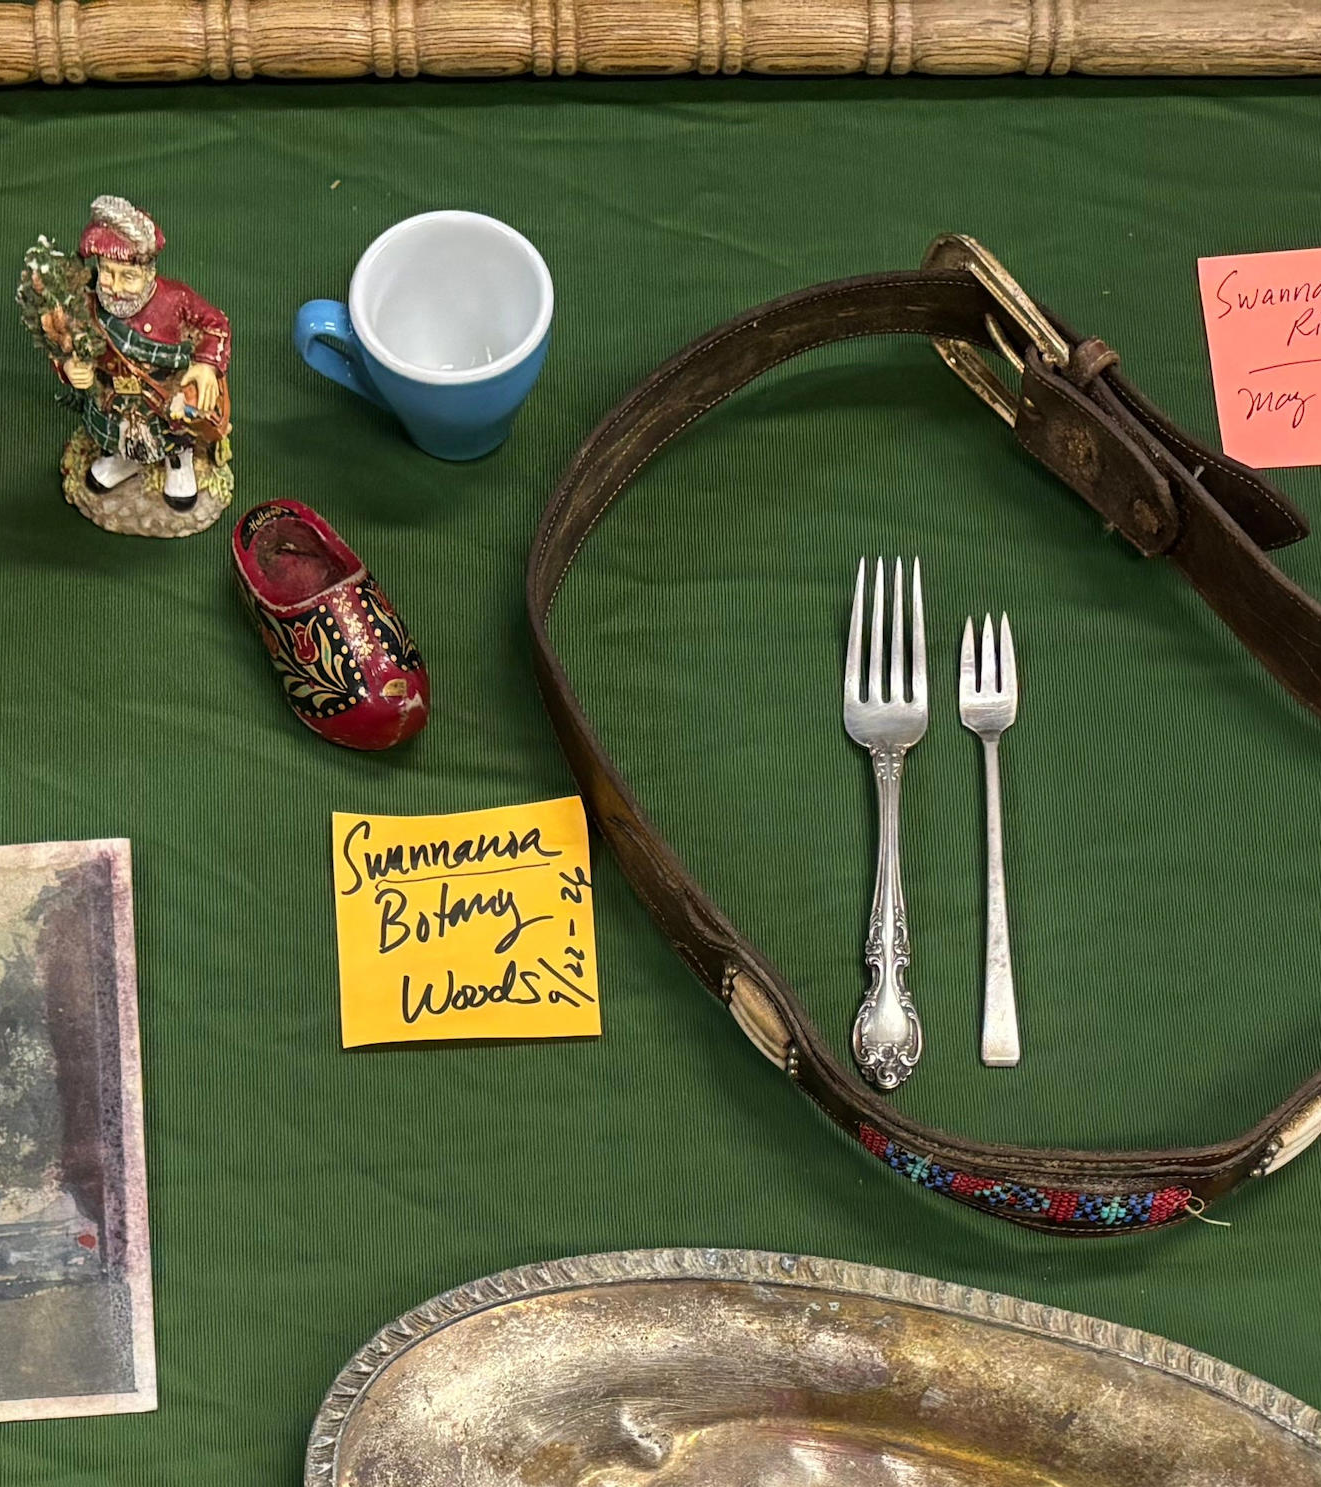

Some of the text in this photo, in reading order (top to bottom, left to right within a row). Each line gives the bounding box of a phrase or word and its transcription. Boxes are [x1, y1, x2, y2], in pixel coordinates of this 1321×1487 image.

[1237, 387, 1316, 429] May
[341, 820, 563, 895] Swannanoa
[375, 882, 554, 954] Botany
[402, 960, 541, 1023] Woods
